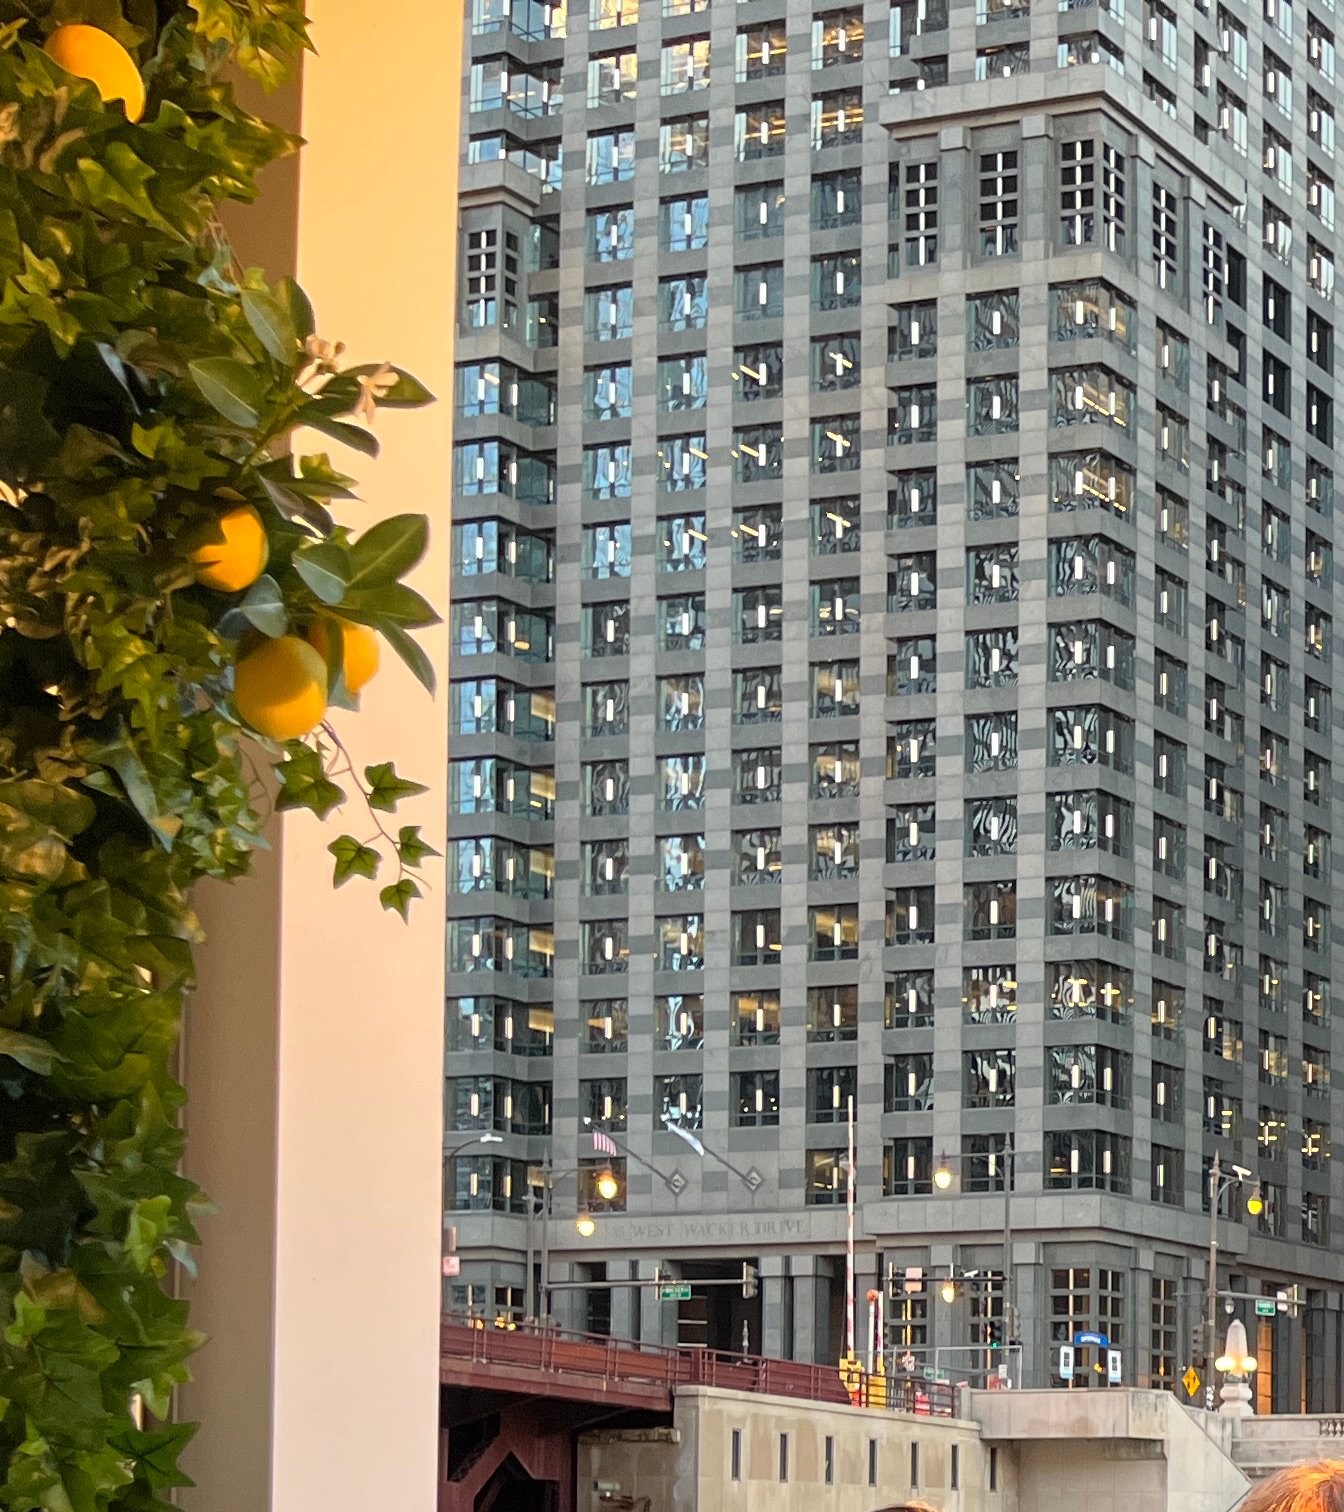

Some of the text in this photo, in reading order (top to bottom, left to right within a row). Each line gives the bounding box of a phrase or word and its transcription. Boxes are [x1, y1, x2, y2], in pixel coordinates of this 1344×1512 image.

[632, 1224, 674, 1238] WEST
[685, 1221, 749, 1237] WACKER
[756, 1219, 803, 1234] DRIVE
